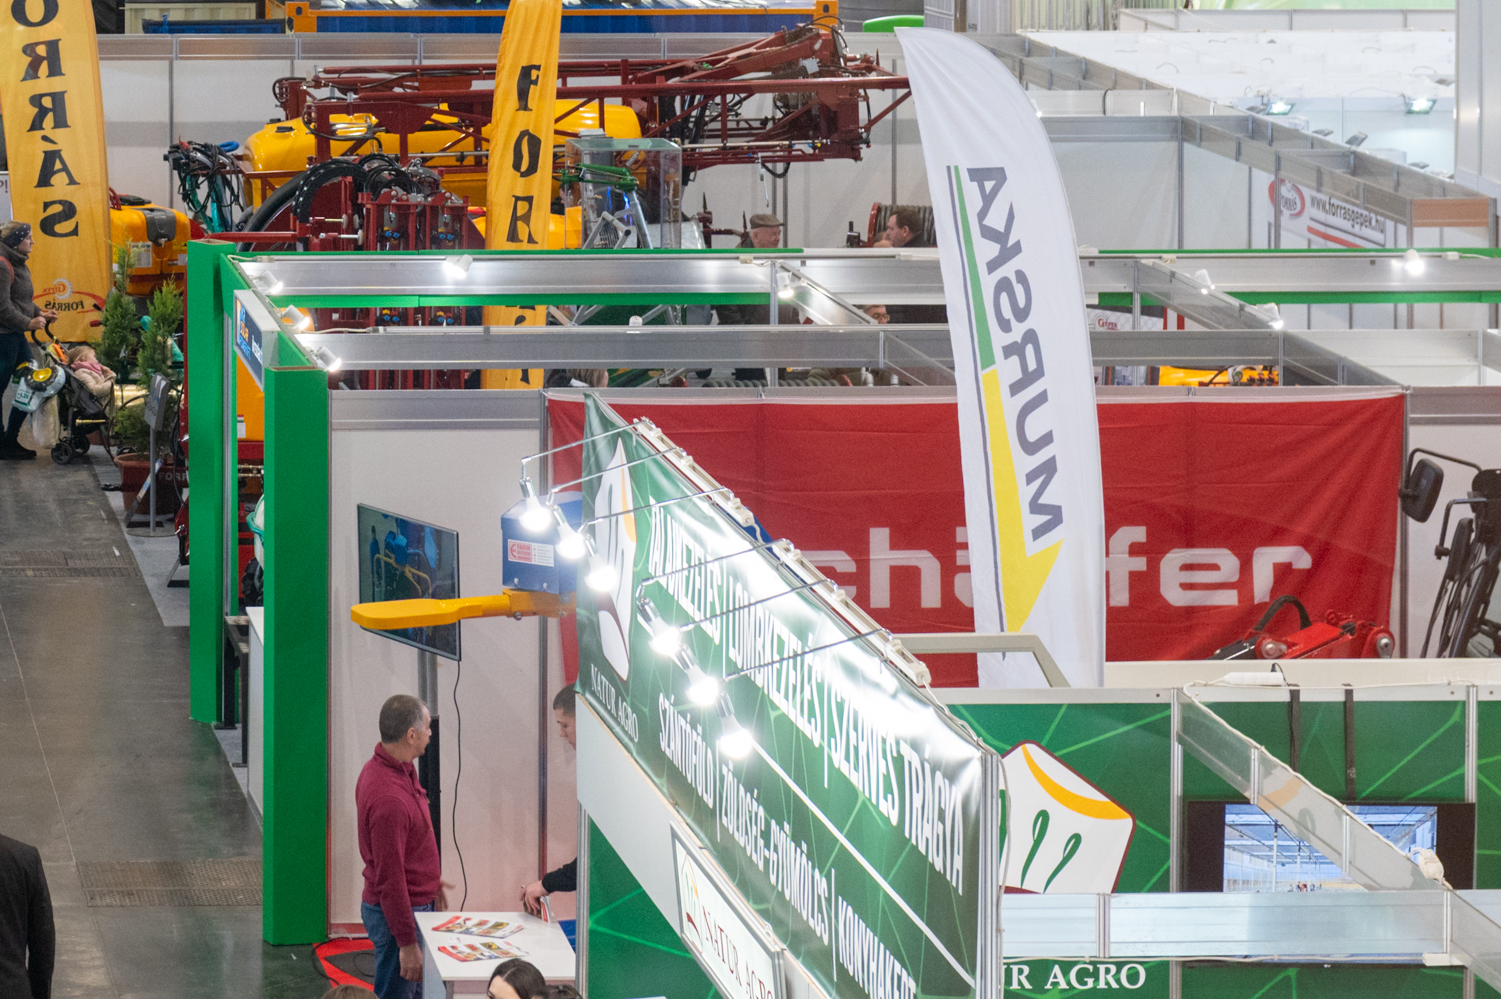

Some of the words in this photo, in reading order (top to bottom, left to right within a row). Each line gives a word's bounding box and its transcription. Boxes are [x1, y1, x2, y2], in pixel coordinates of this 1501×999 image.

[1309, 194, 1386, 234] www.forrasgepek.hu
[590, 663, 617, 716] NATUR
[617, 687, 639, 744] AGRO
[729, 575, 822, 749] LOMBKEZELÉS
[830, 674, 899, 827] SZERVES
[899, 738, 964, 896] TRÁGYA
[658, 691, 714, 810] SZÁNTÓFÖLD
[721, 761, 829, 946] ZÖLDSÉG-GYÜMÖLCS
[702, 905, 743, 987] NATUR
[1044, 963, 1147, 990] AGRO
